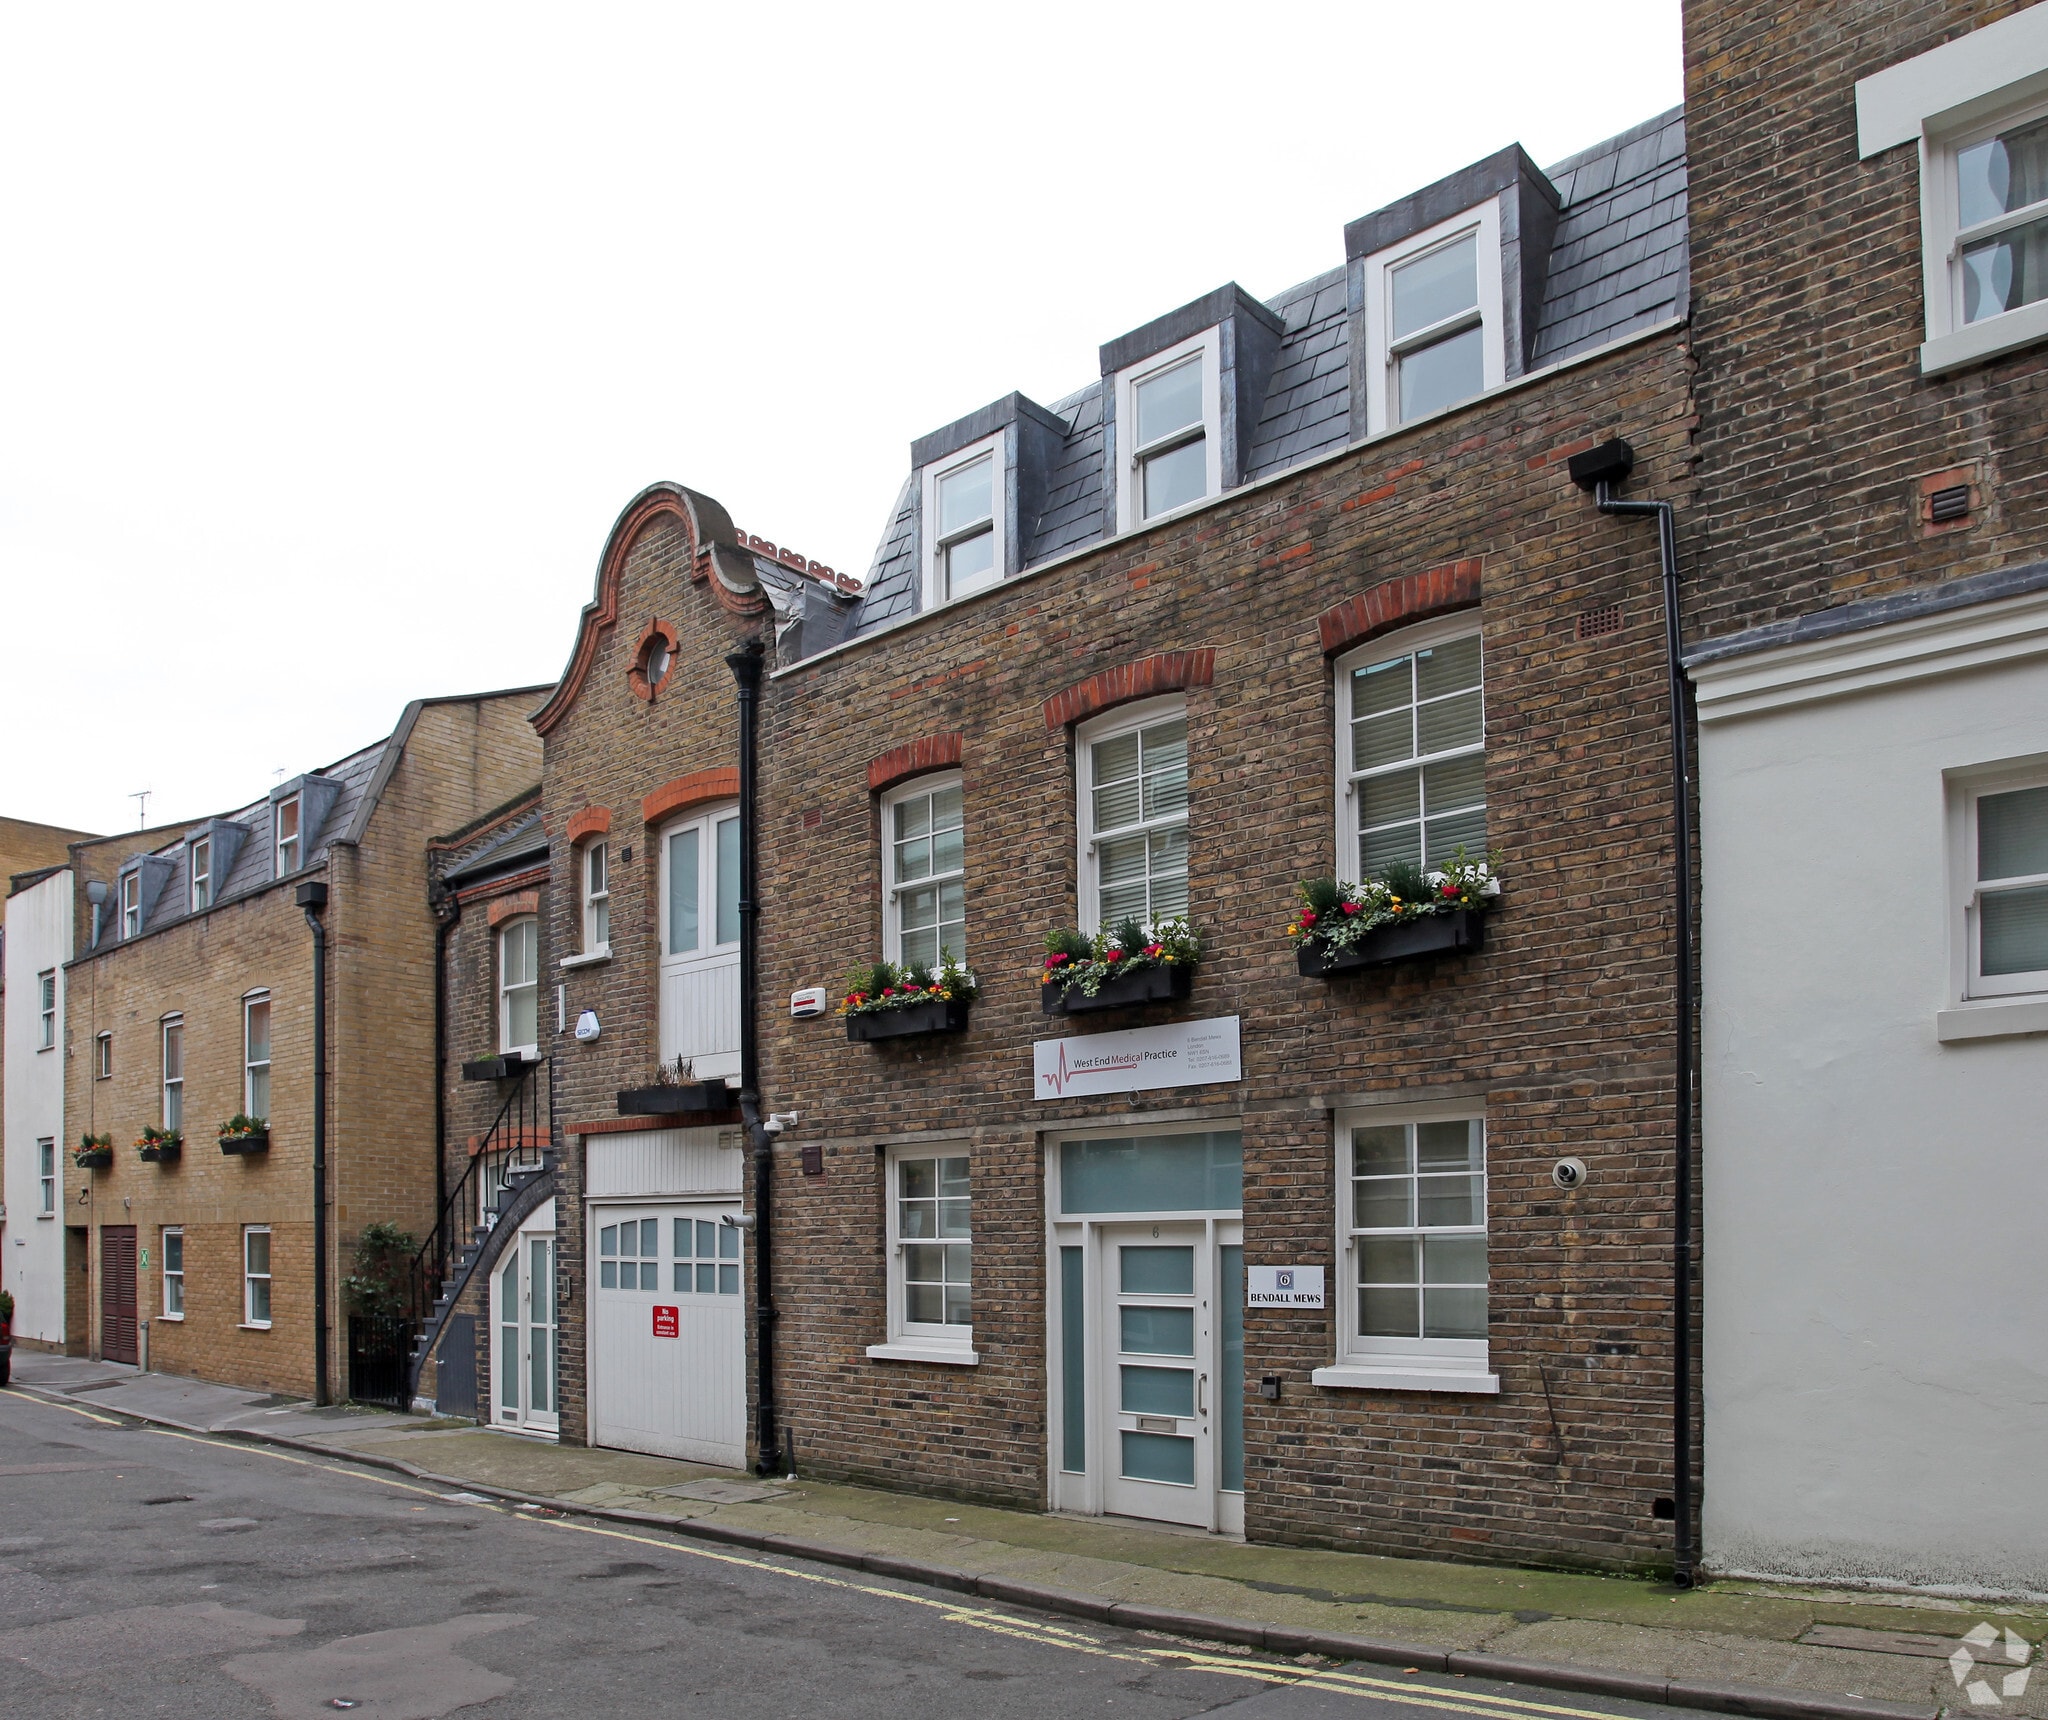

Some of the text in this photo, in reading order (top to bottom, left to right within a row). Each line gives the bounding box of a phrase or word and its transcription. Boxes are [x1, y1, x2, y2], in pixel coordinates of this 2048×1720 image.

[1073, 1049, 1177, 1068] West End Medical Practice
[1152, 1225, 1159, 1239] 6
[1281, 1275, 1288, 1284] 6
[1250, 1293, 1321, 1304] BENDALL MEWS
[657, 1315, 674, 1323] parking
